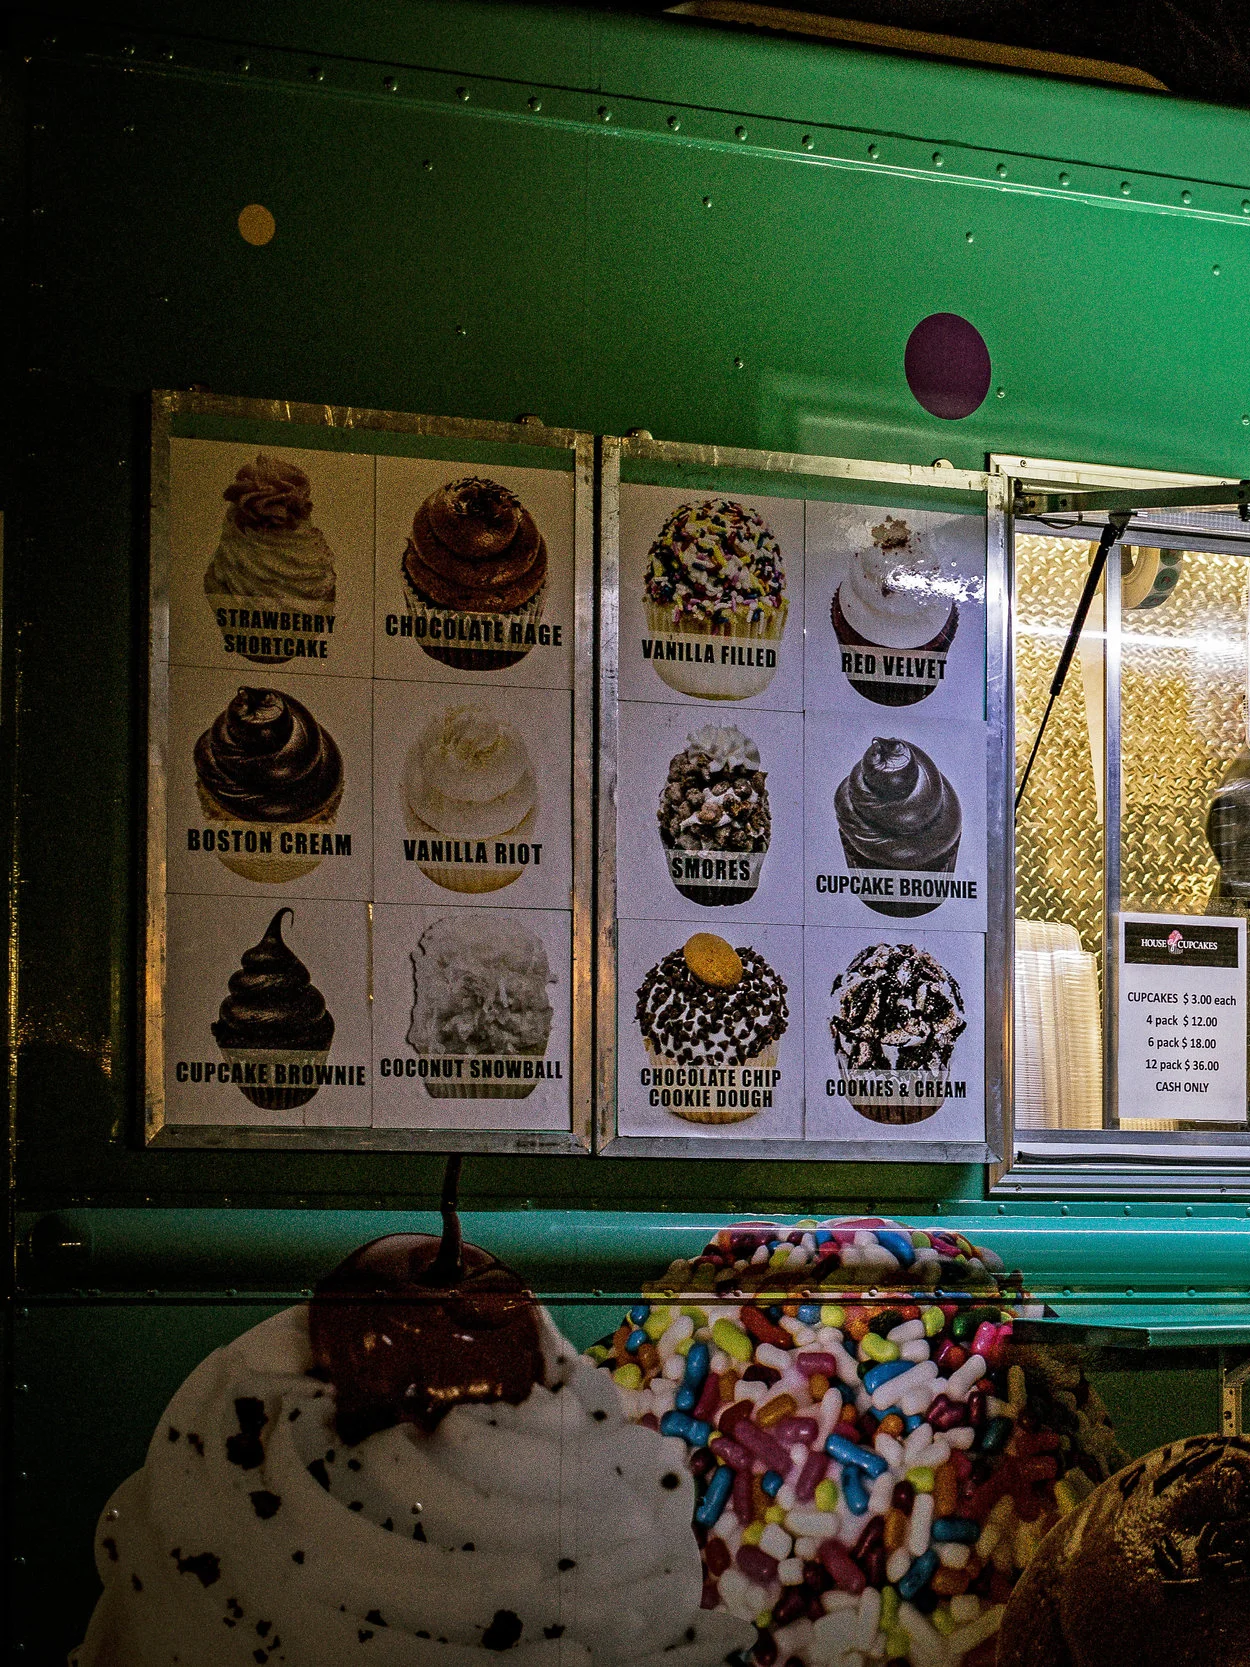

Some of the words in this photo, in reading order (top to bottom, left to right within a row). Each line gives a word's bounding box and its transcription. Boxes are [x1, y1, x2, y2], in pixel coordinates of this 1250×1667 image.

[217, 607, 335, 634] STRAWBERRY
[385, 614, 503, 643] CHOCOLATE
[511, 622, 562, 646] RAGE
[224, 634, 328, 658] SHORTCAKE
[641, 639, 715, 664] VANILLA
[721, 646, 777, 668] FILLED
[841, 651, 876, 674] RED
[883, 656, 947, 680] VELVET
[188, 829, 271, 853] BOSTON
[280, 832, 352, 856] CREAM
[404, 839, 488, 863] VANILLA
[496, 843, 542, 865] RIOT
[672, 858, 750, 881] SMORES
[816, 874, 894, 896] CUPCAKE
[900, 877, 977, 899] BROWNIE
[1141, 938, 1167, 948] HOUSE
[1177, 940, 1218, 950] CUPCAKES
[1127, 991, 1178, 1004] CUPCAKES
[1183, 993, 1189, 1005] $
[1191, 994, 1212, 1005] 3.00
[1214, 995, 1237, 1006] each
[1146, 1015, 1153, 1025] 4
[1155, 1015, 1178, 1028] pack
[1183, 1015, 1189, 1027] $
[1191, 1016, 1218, 1027] 12.00
[1148, 1037, 1154, 1047] 6
[1157, 1037, 1180, 1050] pack
[1182, 1037, 1187, 1049] $
[1191, 1038, 1217, 1049] 18.00
[176, 1062, 267, 1084] CUPCAKE
[275, 1063, 365, 1086] BROWNIE
[380, 1058, 464, 1078] COCONUT
[470, 1060, 562, 1080] SNOWBALL
[1145, 1059, 1157, 1069] 12
[1160, 1059, 1182, 1072] pack
[1184, 1060, 1190, 1072] $
[1193, 1061, 1219, 1071] 36.00
[640, 1067, 737, 1088] CHOCOLATE
[742, 1069, 781, 1088] CHIP
[825, 1079, 893, 1097] COOKIES
[899, 1083, 909, 1097] &
[915, 1081, 966, 1098] CREAM
[1156, 1081, 1181, 1093] CASH
[1184, 1082, 1210, 1093] ONLY
[650, 1088, 711, 1107] COOKIE
[716, 1090, 773, 1108] DOUGH
